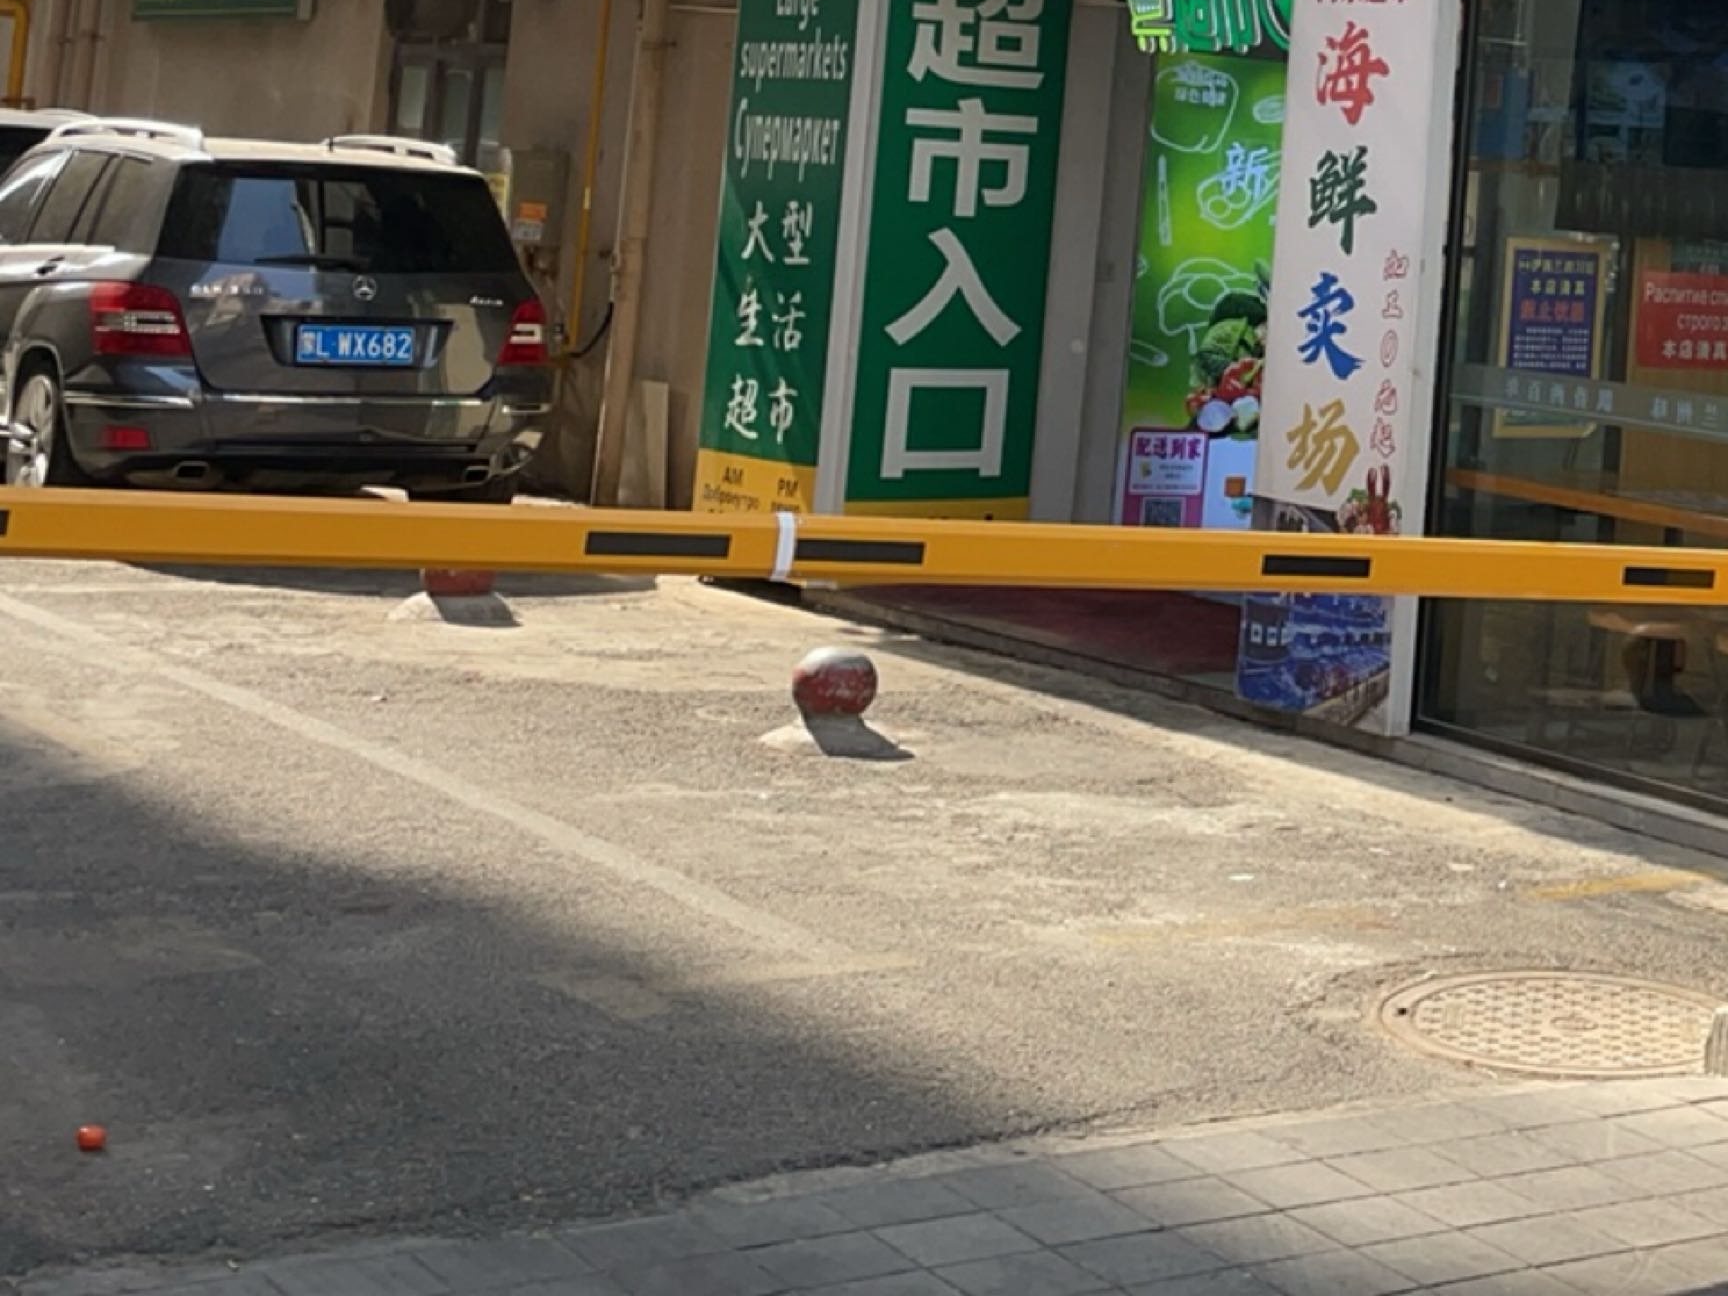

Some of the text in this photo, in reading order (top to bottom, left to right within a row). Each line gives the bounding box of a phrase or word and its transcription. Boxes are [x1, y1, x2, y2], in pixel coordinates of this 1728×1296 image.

[740, 27, 849, 93] supermarkets
[734, 97, 841, 183] Супермаркет
[740, 201, 814, 267] 大型
[1285, 21, 1390, 496] 海鲜卖场
[734, 274, 808, 349] 生活
[723, 377, 799, 445] 超市
